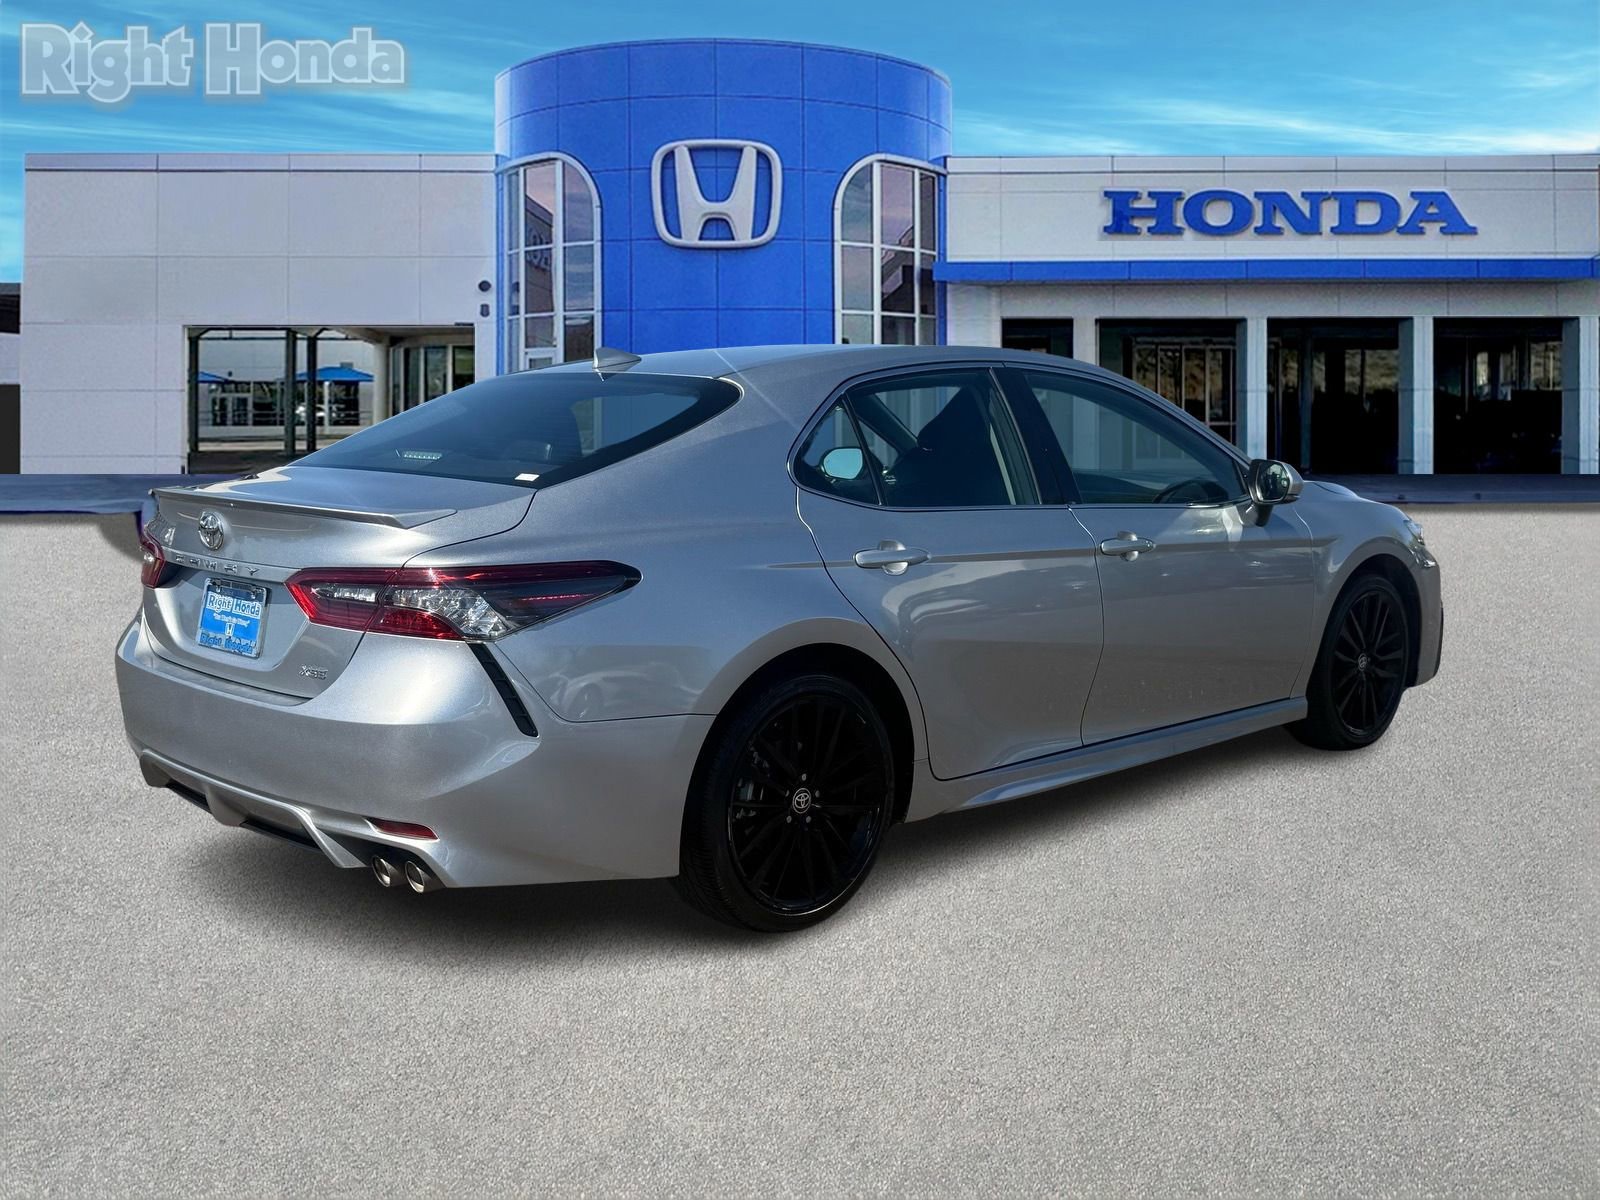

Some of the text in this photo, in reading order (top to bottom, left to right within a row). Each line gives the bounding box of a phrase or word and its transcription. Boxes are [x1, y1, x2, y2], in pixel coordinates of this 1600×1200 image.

[1103, 189, 1478, 235] HONDA
[208, 594, 261, 617] Right Honda
